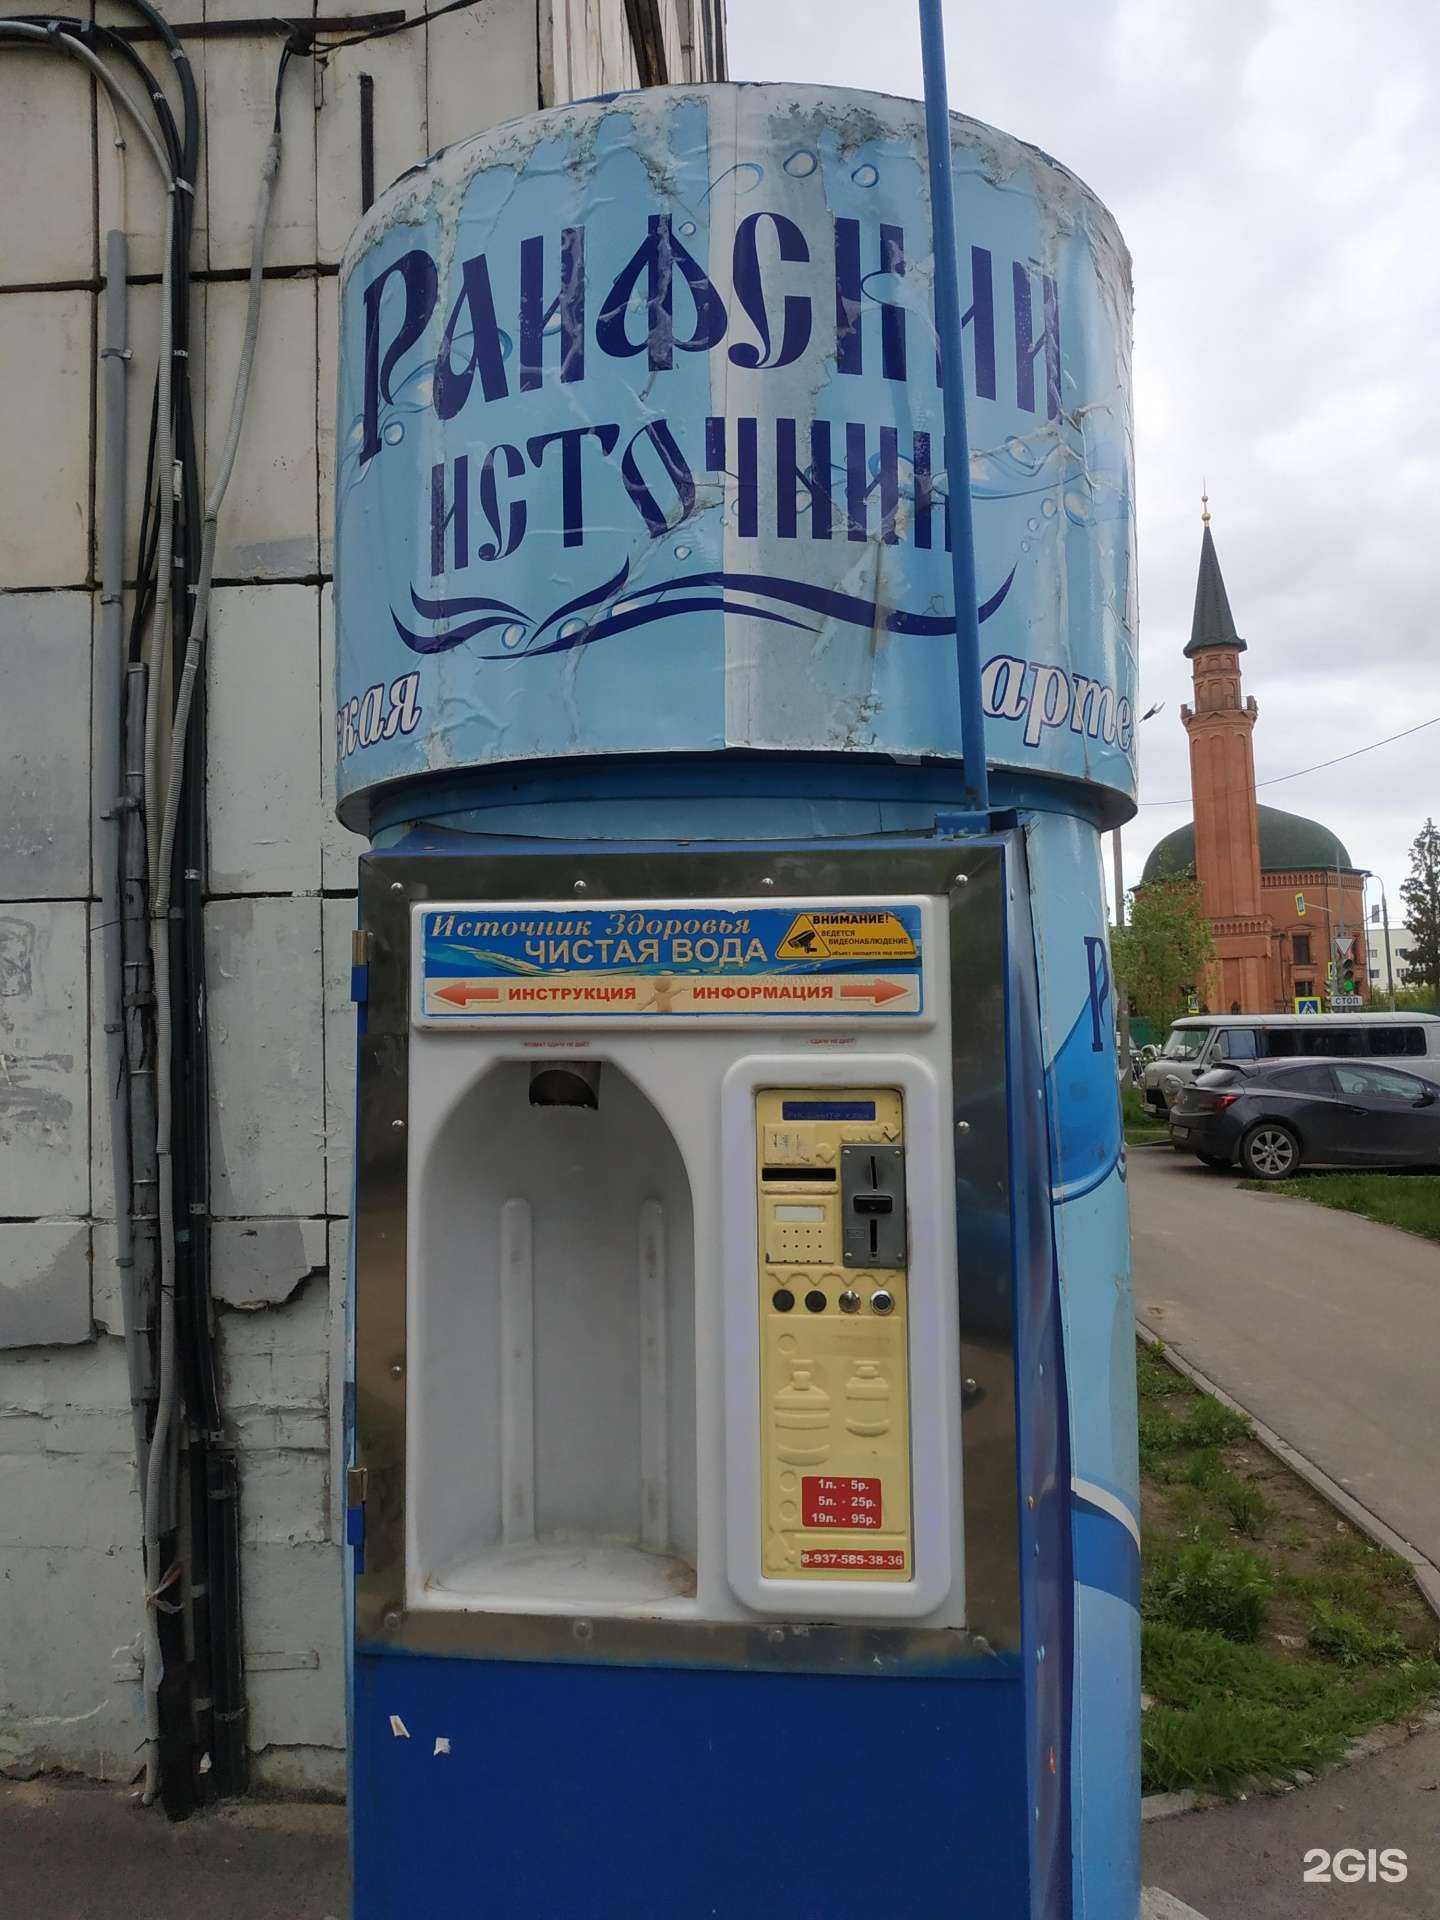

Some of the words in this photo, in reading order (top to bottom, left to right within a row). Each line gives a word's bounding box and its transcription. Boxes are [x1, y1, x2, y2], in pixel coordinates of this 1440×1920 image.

[813, 912, 889, 925] ВНИМАНИЕ!
[432, 914, 592, 937] Источник
[604, 913, 750, 940] Здоровья
[525, 939, 659, 963] ЧИСТАЯ
[672, 938, 768, 967] ВОДА
[508, 987, 637, 1001] ИНСТРУКЦИЯ
[693, 986, 834, 1001] ИНФОРМАЦИЯ
[1335, 997, 1359, 1005] СТОП
[851, 1480, 869, 1491] 5р.
[851, 1497, 876, 1509] 25р.
[851, 1514, 877, 1526] 95р.
[801, 1553, 904, 1566] 8-937-585-38-36
